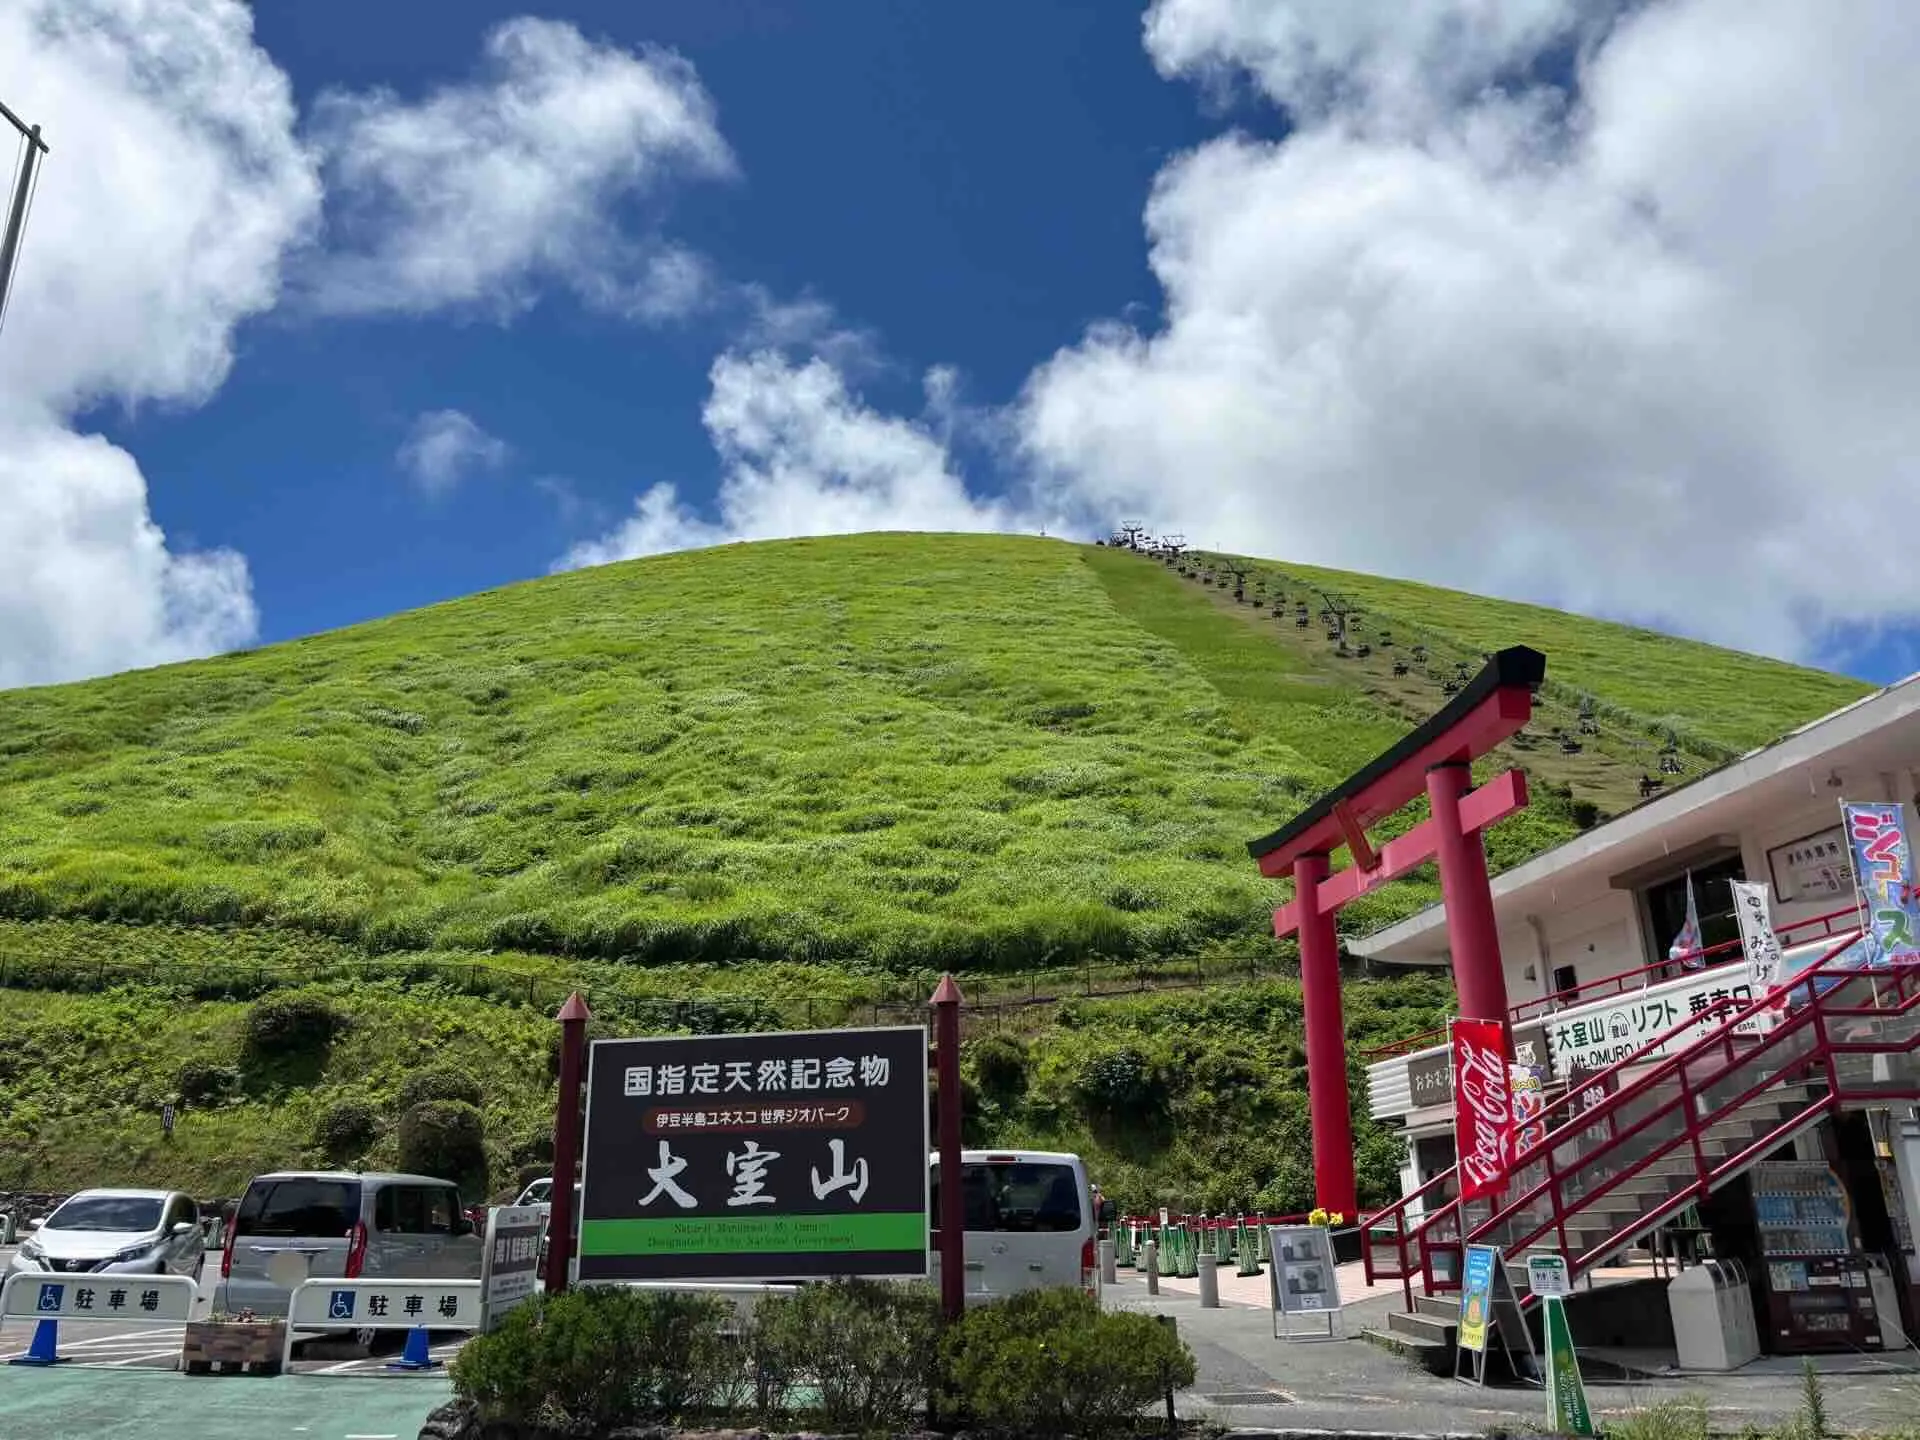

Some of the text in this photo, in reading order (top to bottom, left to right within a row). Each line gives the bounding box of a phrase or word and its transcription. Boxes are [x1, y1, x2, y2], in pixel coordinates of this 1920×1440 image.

[1556, 1016, 1605, 1051] 大室山
[1632, 1000, 1678, 1032] リフト
[624, 1055, 889, 1097] 国指定天然記念物
[638, 1138, 870, 1208] 大室山
[75, 1287, 159, 1312] 駐車場
[367, 1294, 458, 1317] 駐車場
